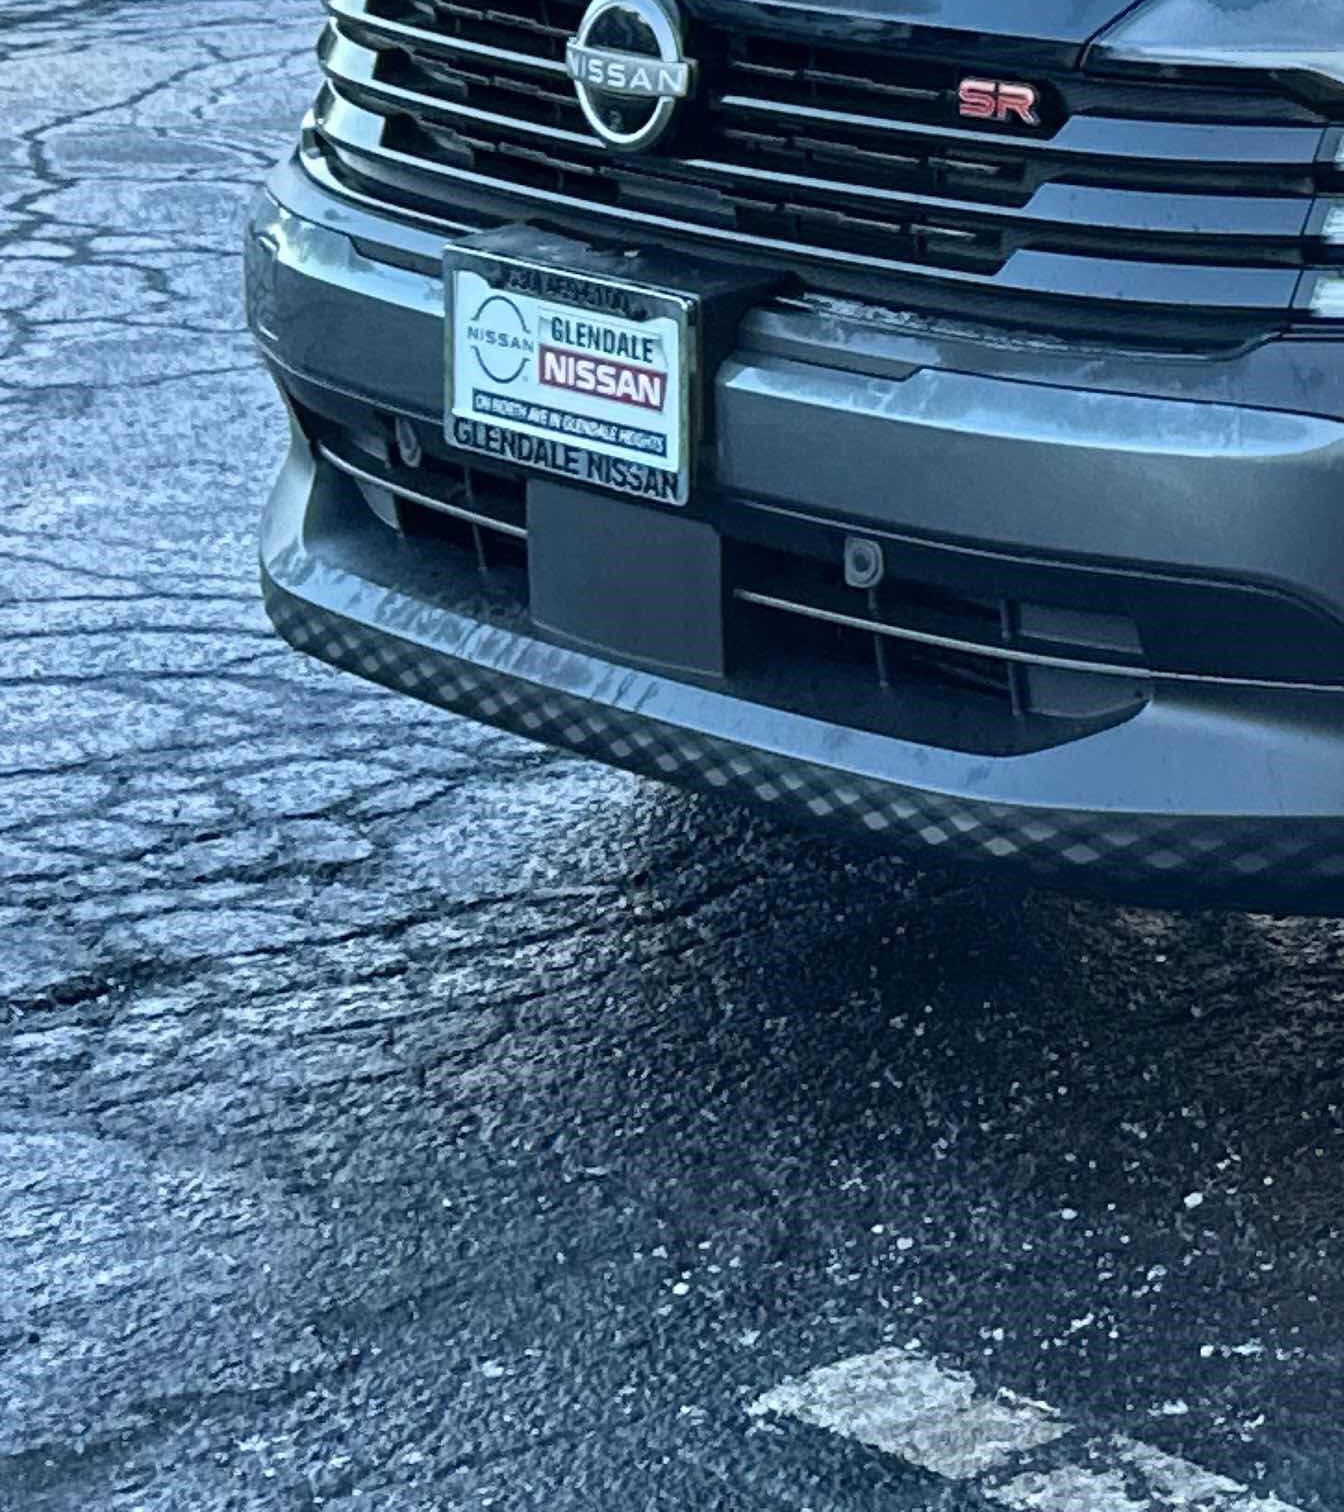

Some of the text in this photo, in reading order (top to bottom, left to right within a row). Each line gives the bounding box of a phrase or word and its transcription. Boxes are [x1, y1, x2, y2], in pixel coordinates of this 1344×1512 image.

[567, 50, 683, 92] NISSAN
[959, 78, 1036, 125] SR
[467, 325, 534, 353] NISSAN
[551, 316, 654, 363] GLENDALE
[544, 351, 661, 408] NISSAN
[453, 416, 679, 501] GLENDALE NISSAN
